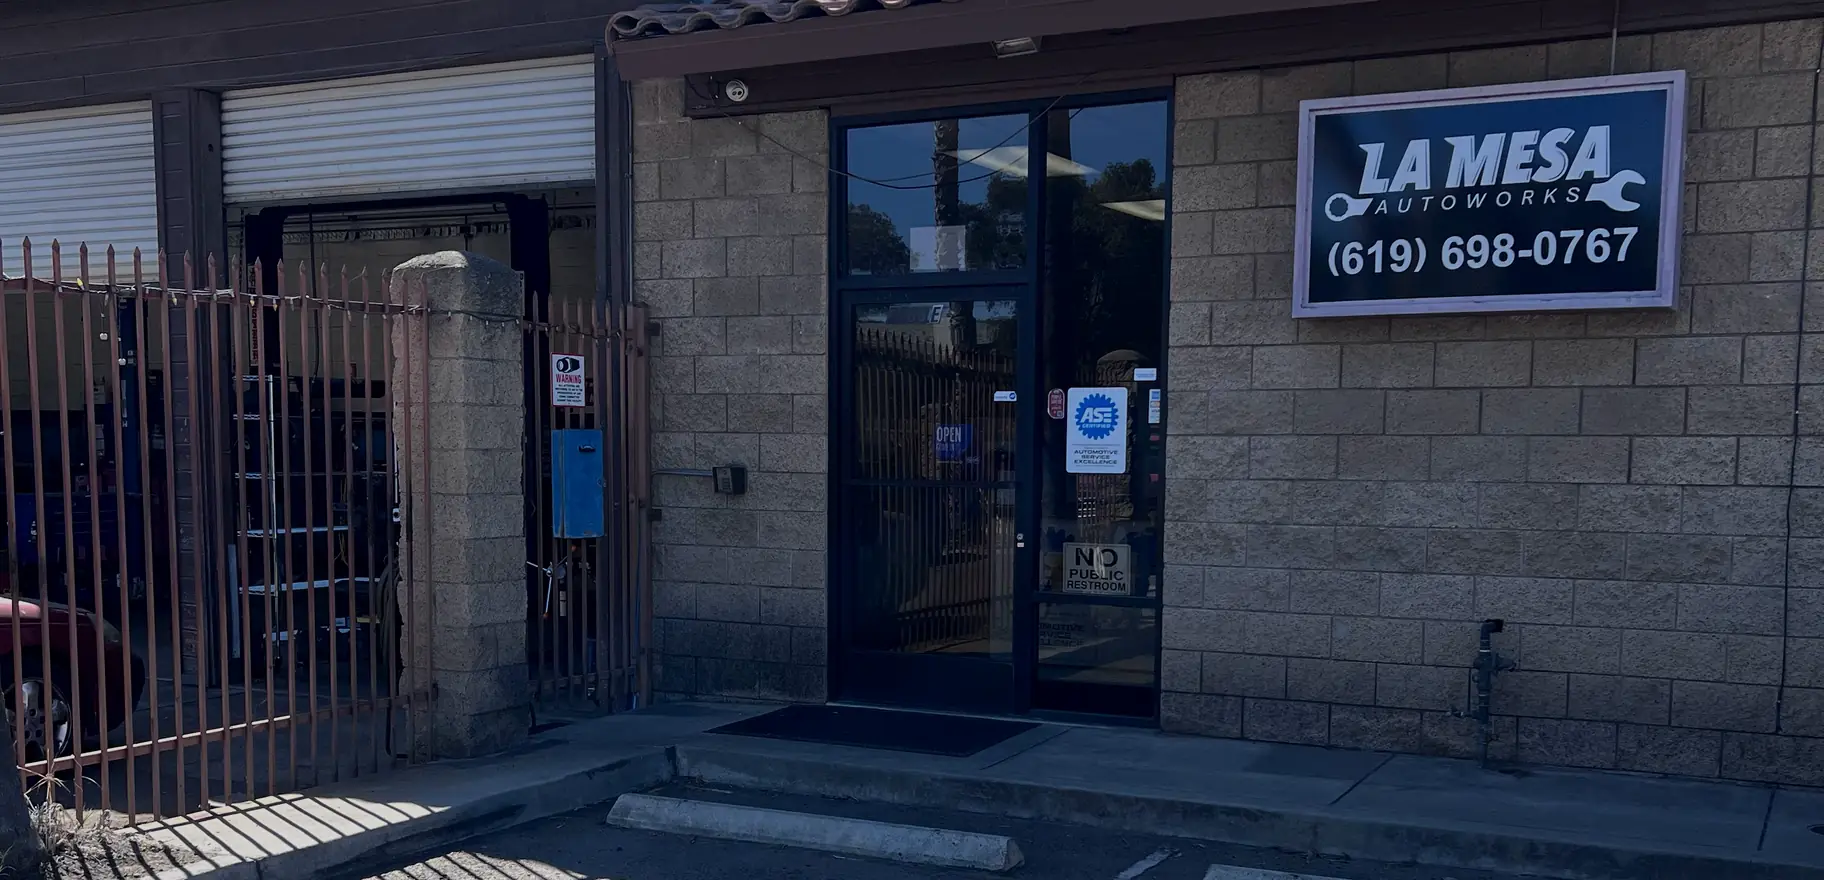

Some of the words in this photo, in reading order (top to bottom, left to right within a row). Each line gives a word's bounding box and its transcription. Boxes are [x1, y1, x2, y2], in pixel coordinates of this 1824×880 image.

[1358, 138, 1430, 194] LA
[1443, 124, 1611, 188] MESA
[1374, 186, 1581, 215] AUTOWORKS
[1327, 237, 1427, 276] (619)
[1441, 226, 1639, 270] 698-0767
[556, 374, 581, 383] WARNING
[1080, 407, 1113, 423] ASE
[936, 426, 961, 443] OPEN
[1075, 547, 1118, 567] NO
[1067, 580, 1126, 592] RESTROOM
